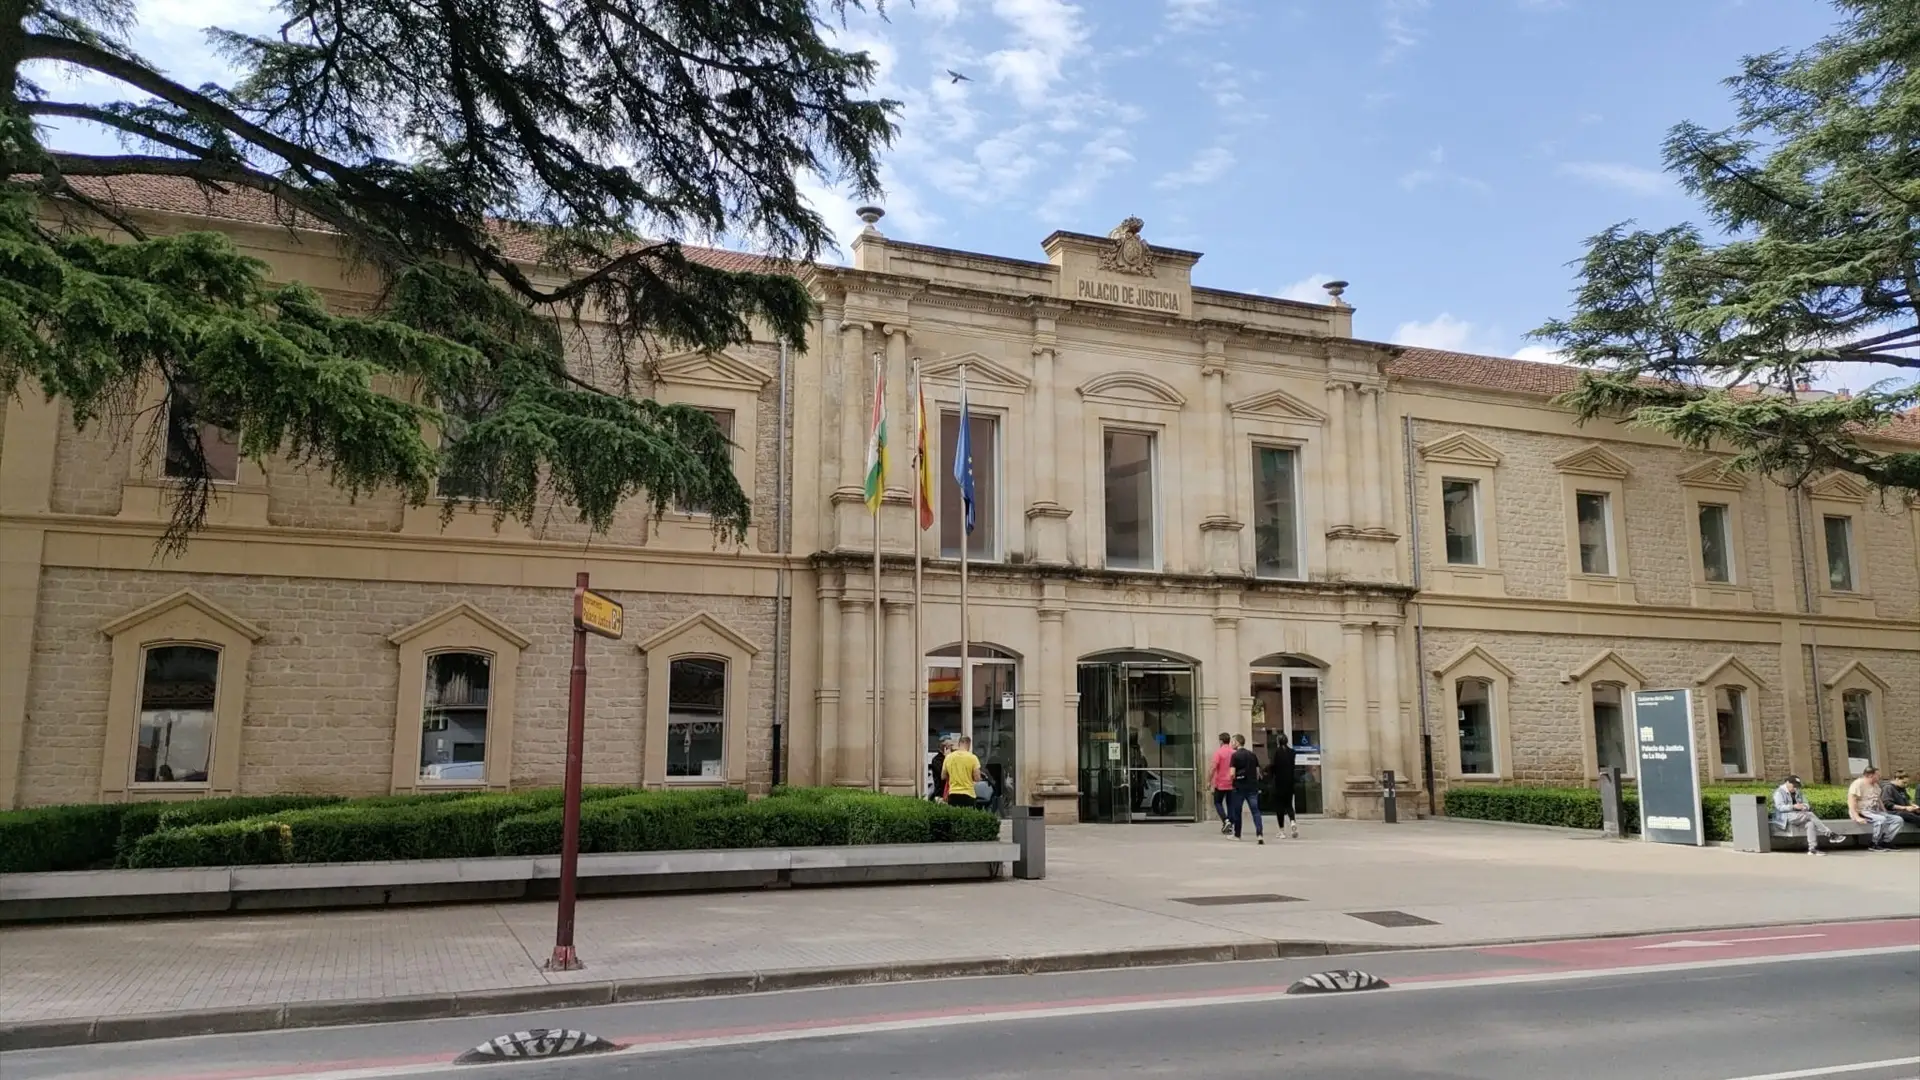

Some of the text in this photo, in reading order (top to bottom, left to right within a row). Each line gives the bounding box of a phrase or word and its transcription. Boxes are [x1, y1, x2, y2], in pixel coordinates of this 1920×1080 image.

[1079, 279, 1179, 311] PALACIO DE JUSTICIA
[1655, 752, 1667, 761] Rioja
